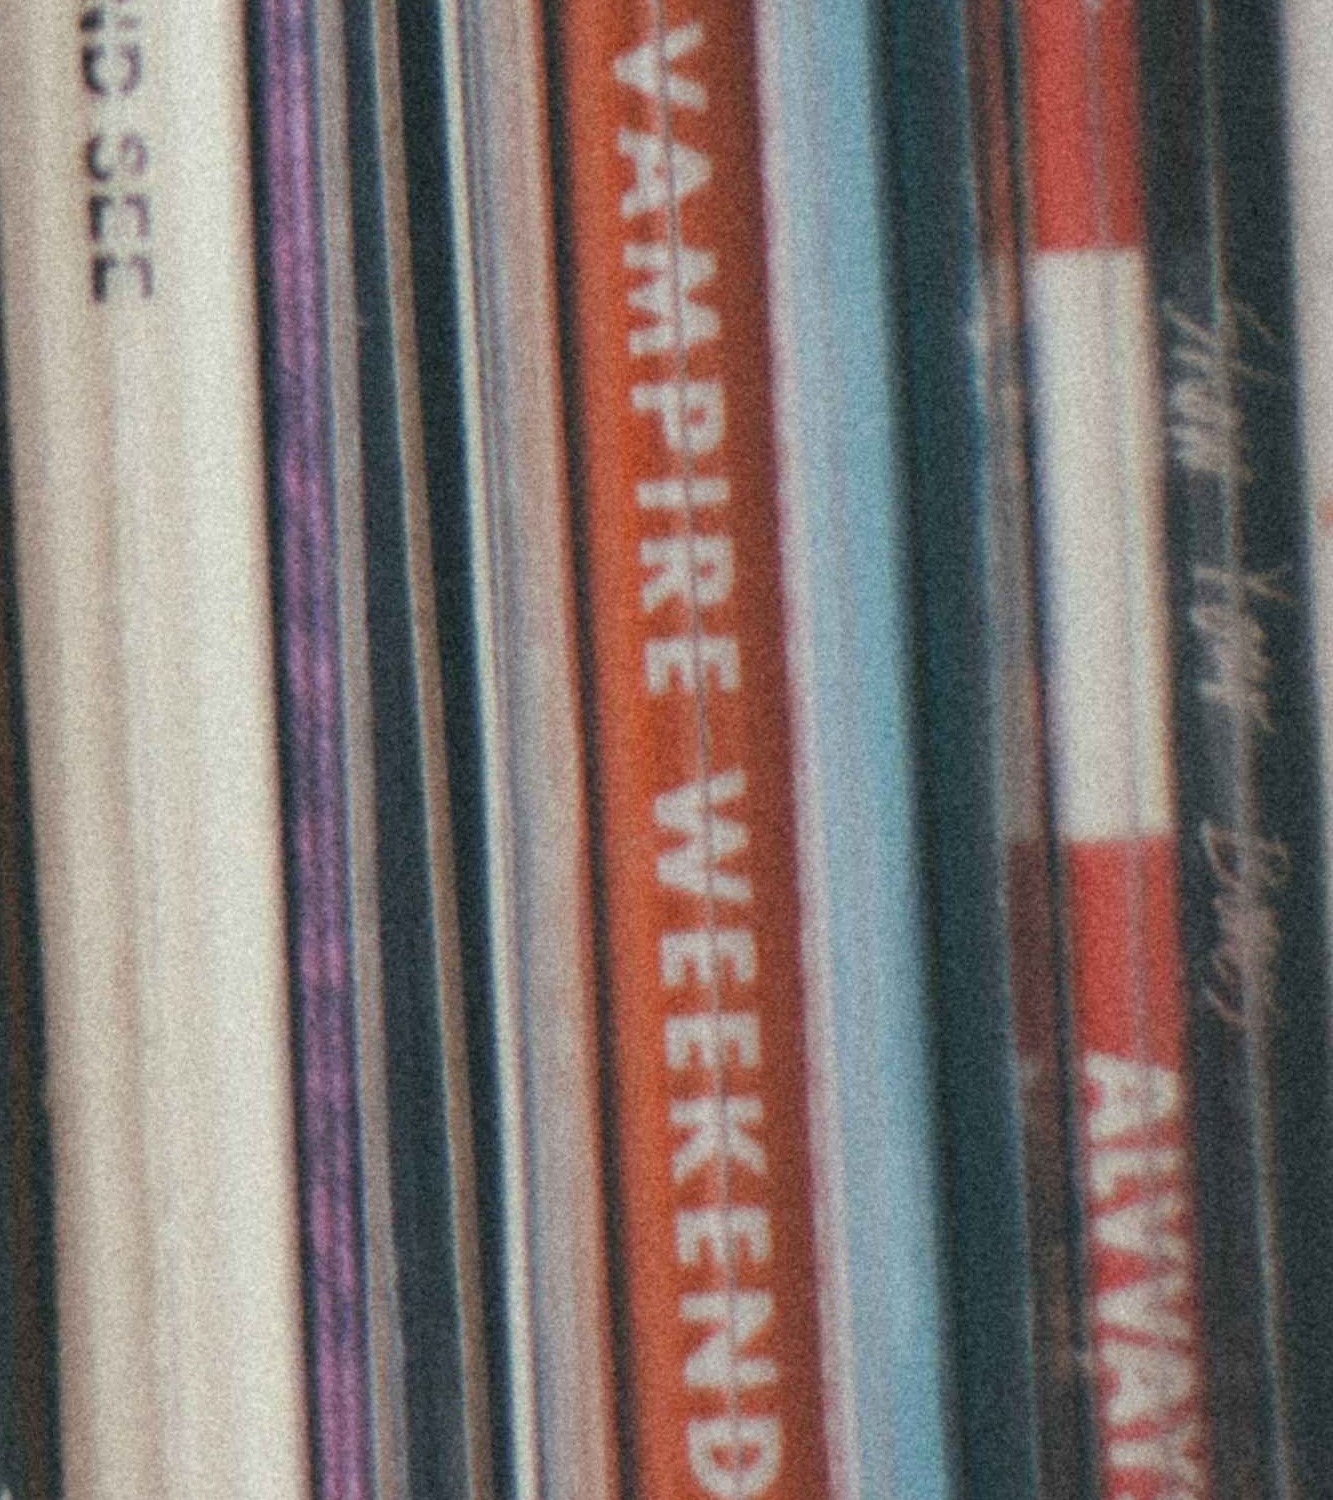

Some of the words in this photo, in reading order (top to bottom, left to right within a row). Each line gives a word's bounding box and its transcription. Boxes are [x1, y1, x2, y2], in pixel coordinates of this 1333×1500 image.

[85, 135, 155, 304] SEE
[611, 25, 743, 697] VAMPIRE
[1191, 563, 1296, 731] Your
[1198, 819, 1292, 1033] Bones
